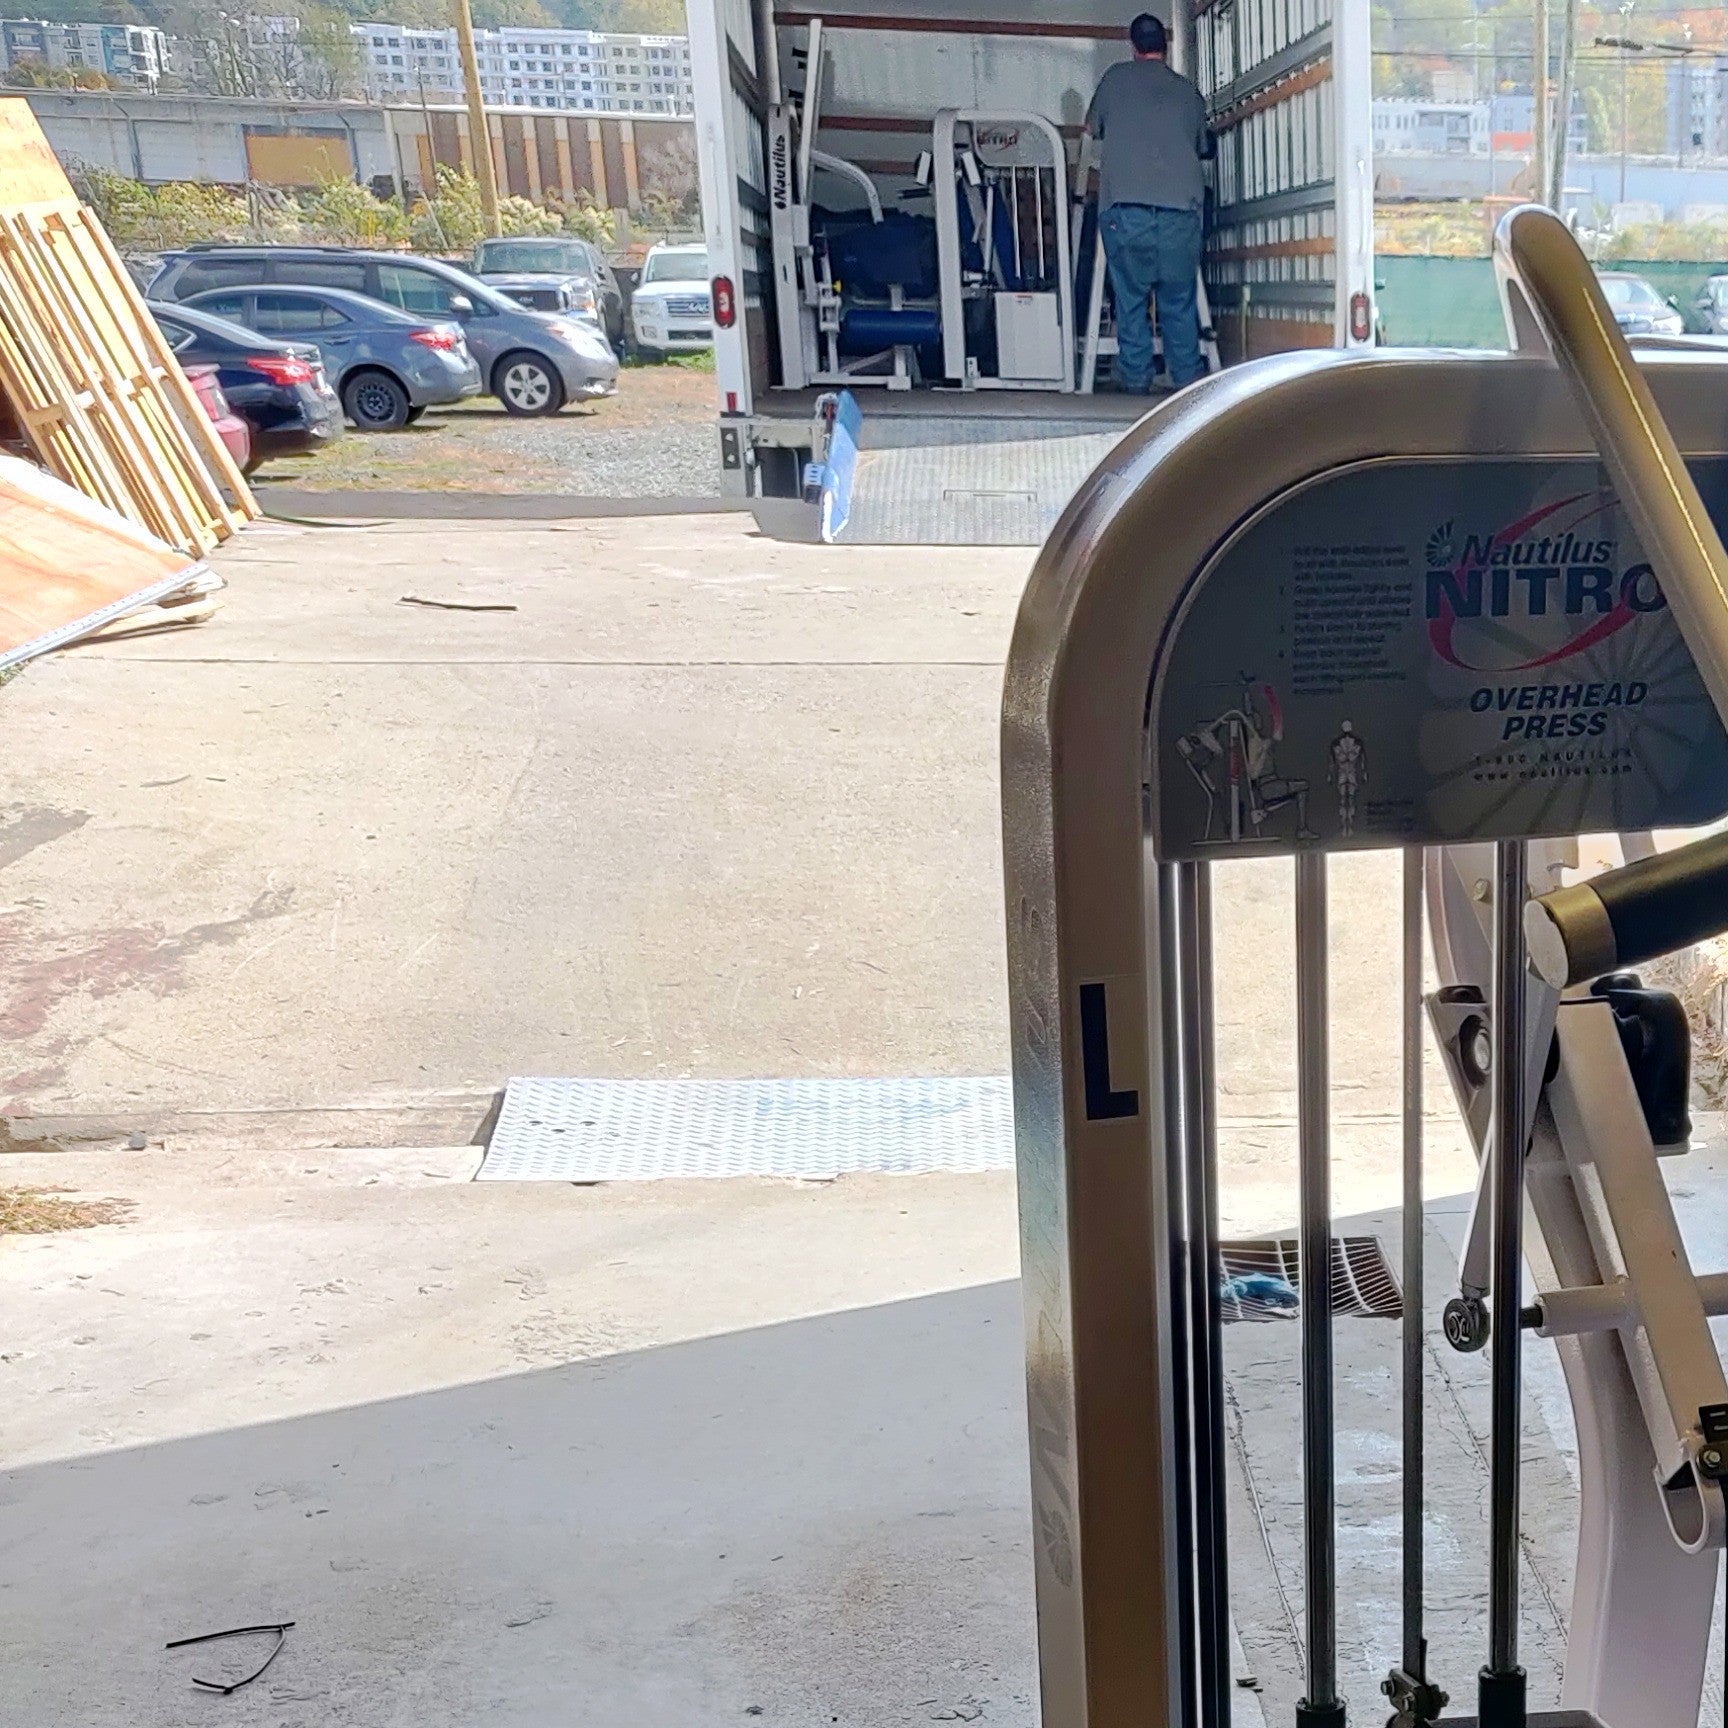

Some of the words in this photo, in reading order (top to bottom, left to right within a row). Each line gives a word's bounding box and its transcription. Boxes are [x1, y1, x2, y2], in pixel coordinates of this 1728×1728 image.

[772, 134, 786, 201] Nautilus
[1461, 532, 1611, 566] Nautilus
[1426, 563, 1668, 619] NITRO
[1470, 681, 1648, 712] OVERHEAD
[1503, 712, 1608, 740] PRESS
[1079, 983, 1138, 1120] L
